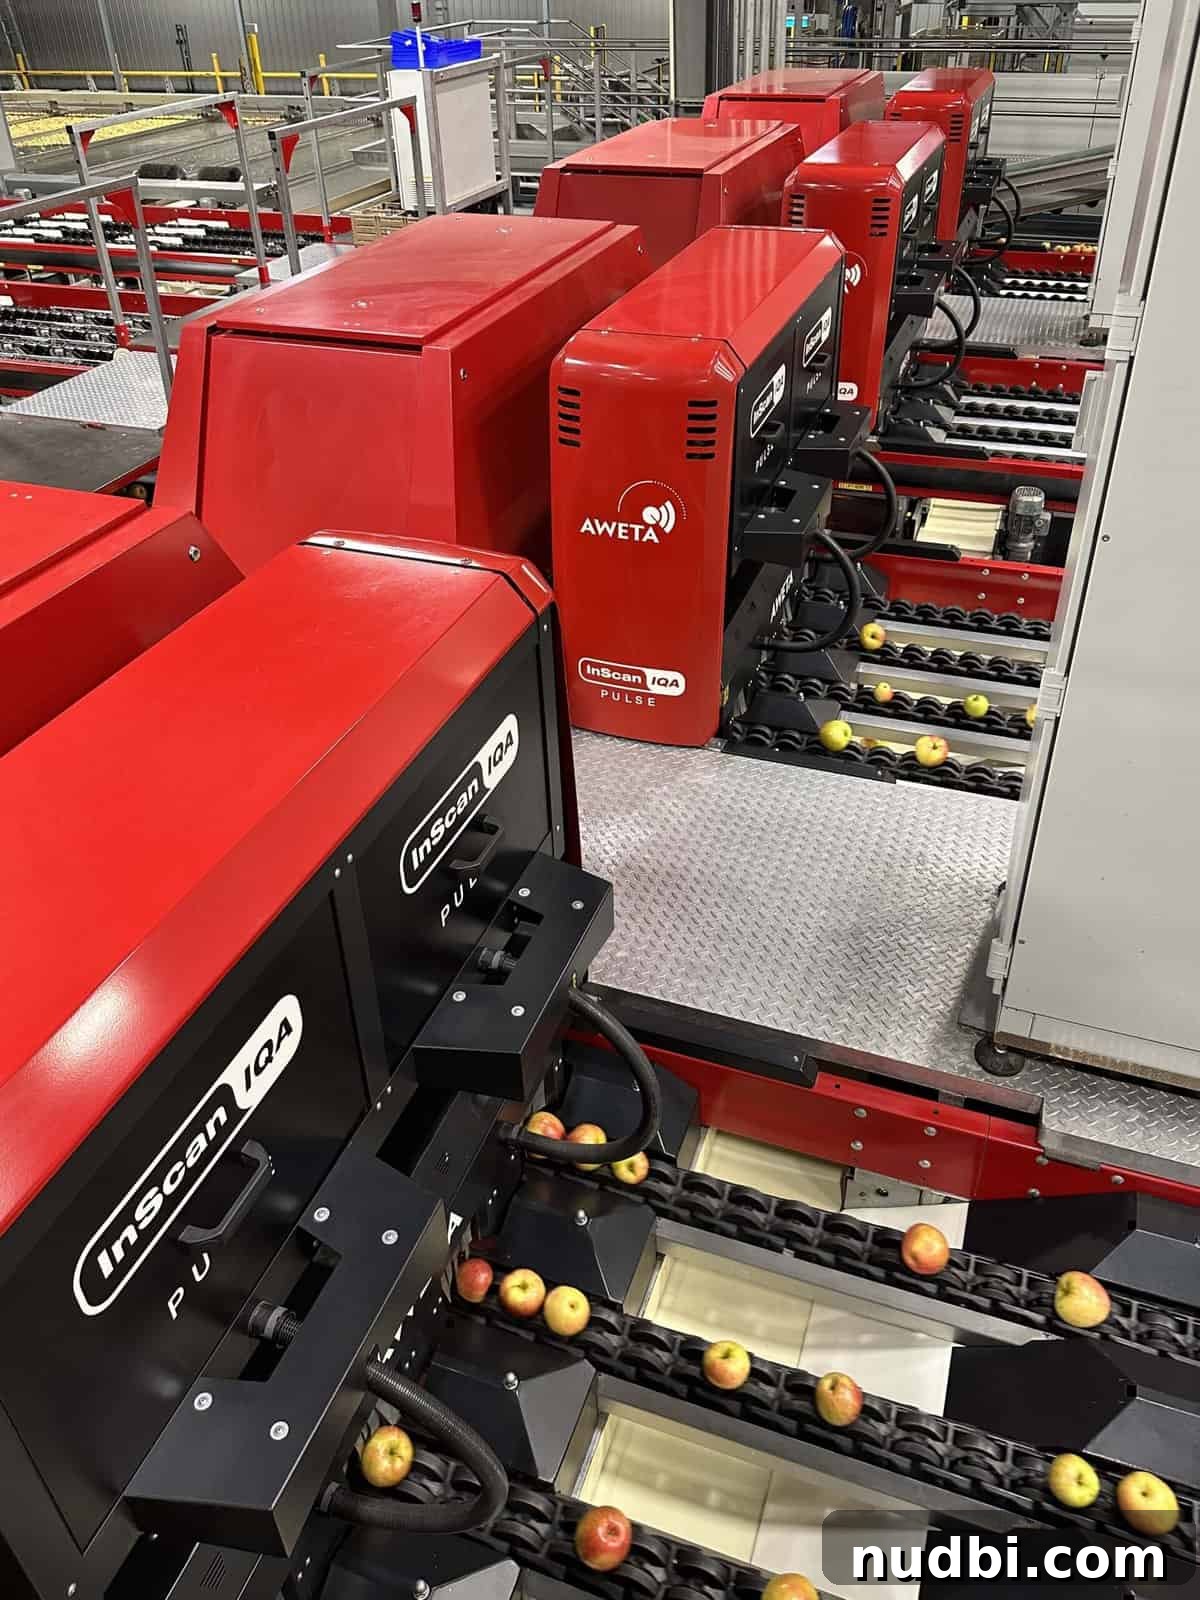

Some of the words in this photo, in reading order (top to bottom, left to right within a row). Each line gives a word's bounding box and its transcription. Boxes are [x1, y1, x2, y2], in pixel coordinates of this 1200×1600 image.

[839, 387, 854, 395] QA
[580, 517, 660, 544] AWETA
[586, 663, 643, 684] InScan
[651, 675, 681, 690] IQA
[600, 689, 657, 707] PULSE
[410, 776, 479, 871] InScan
[487, 729, 515, 774] IQA
[96, 1104, 229, 1280] InScan
[242, 1015, 294, 1093] IQA
